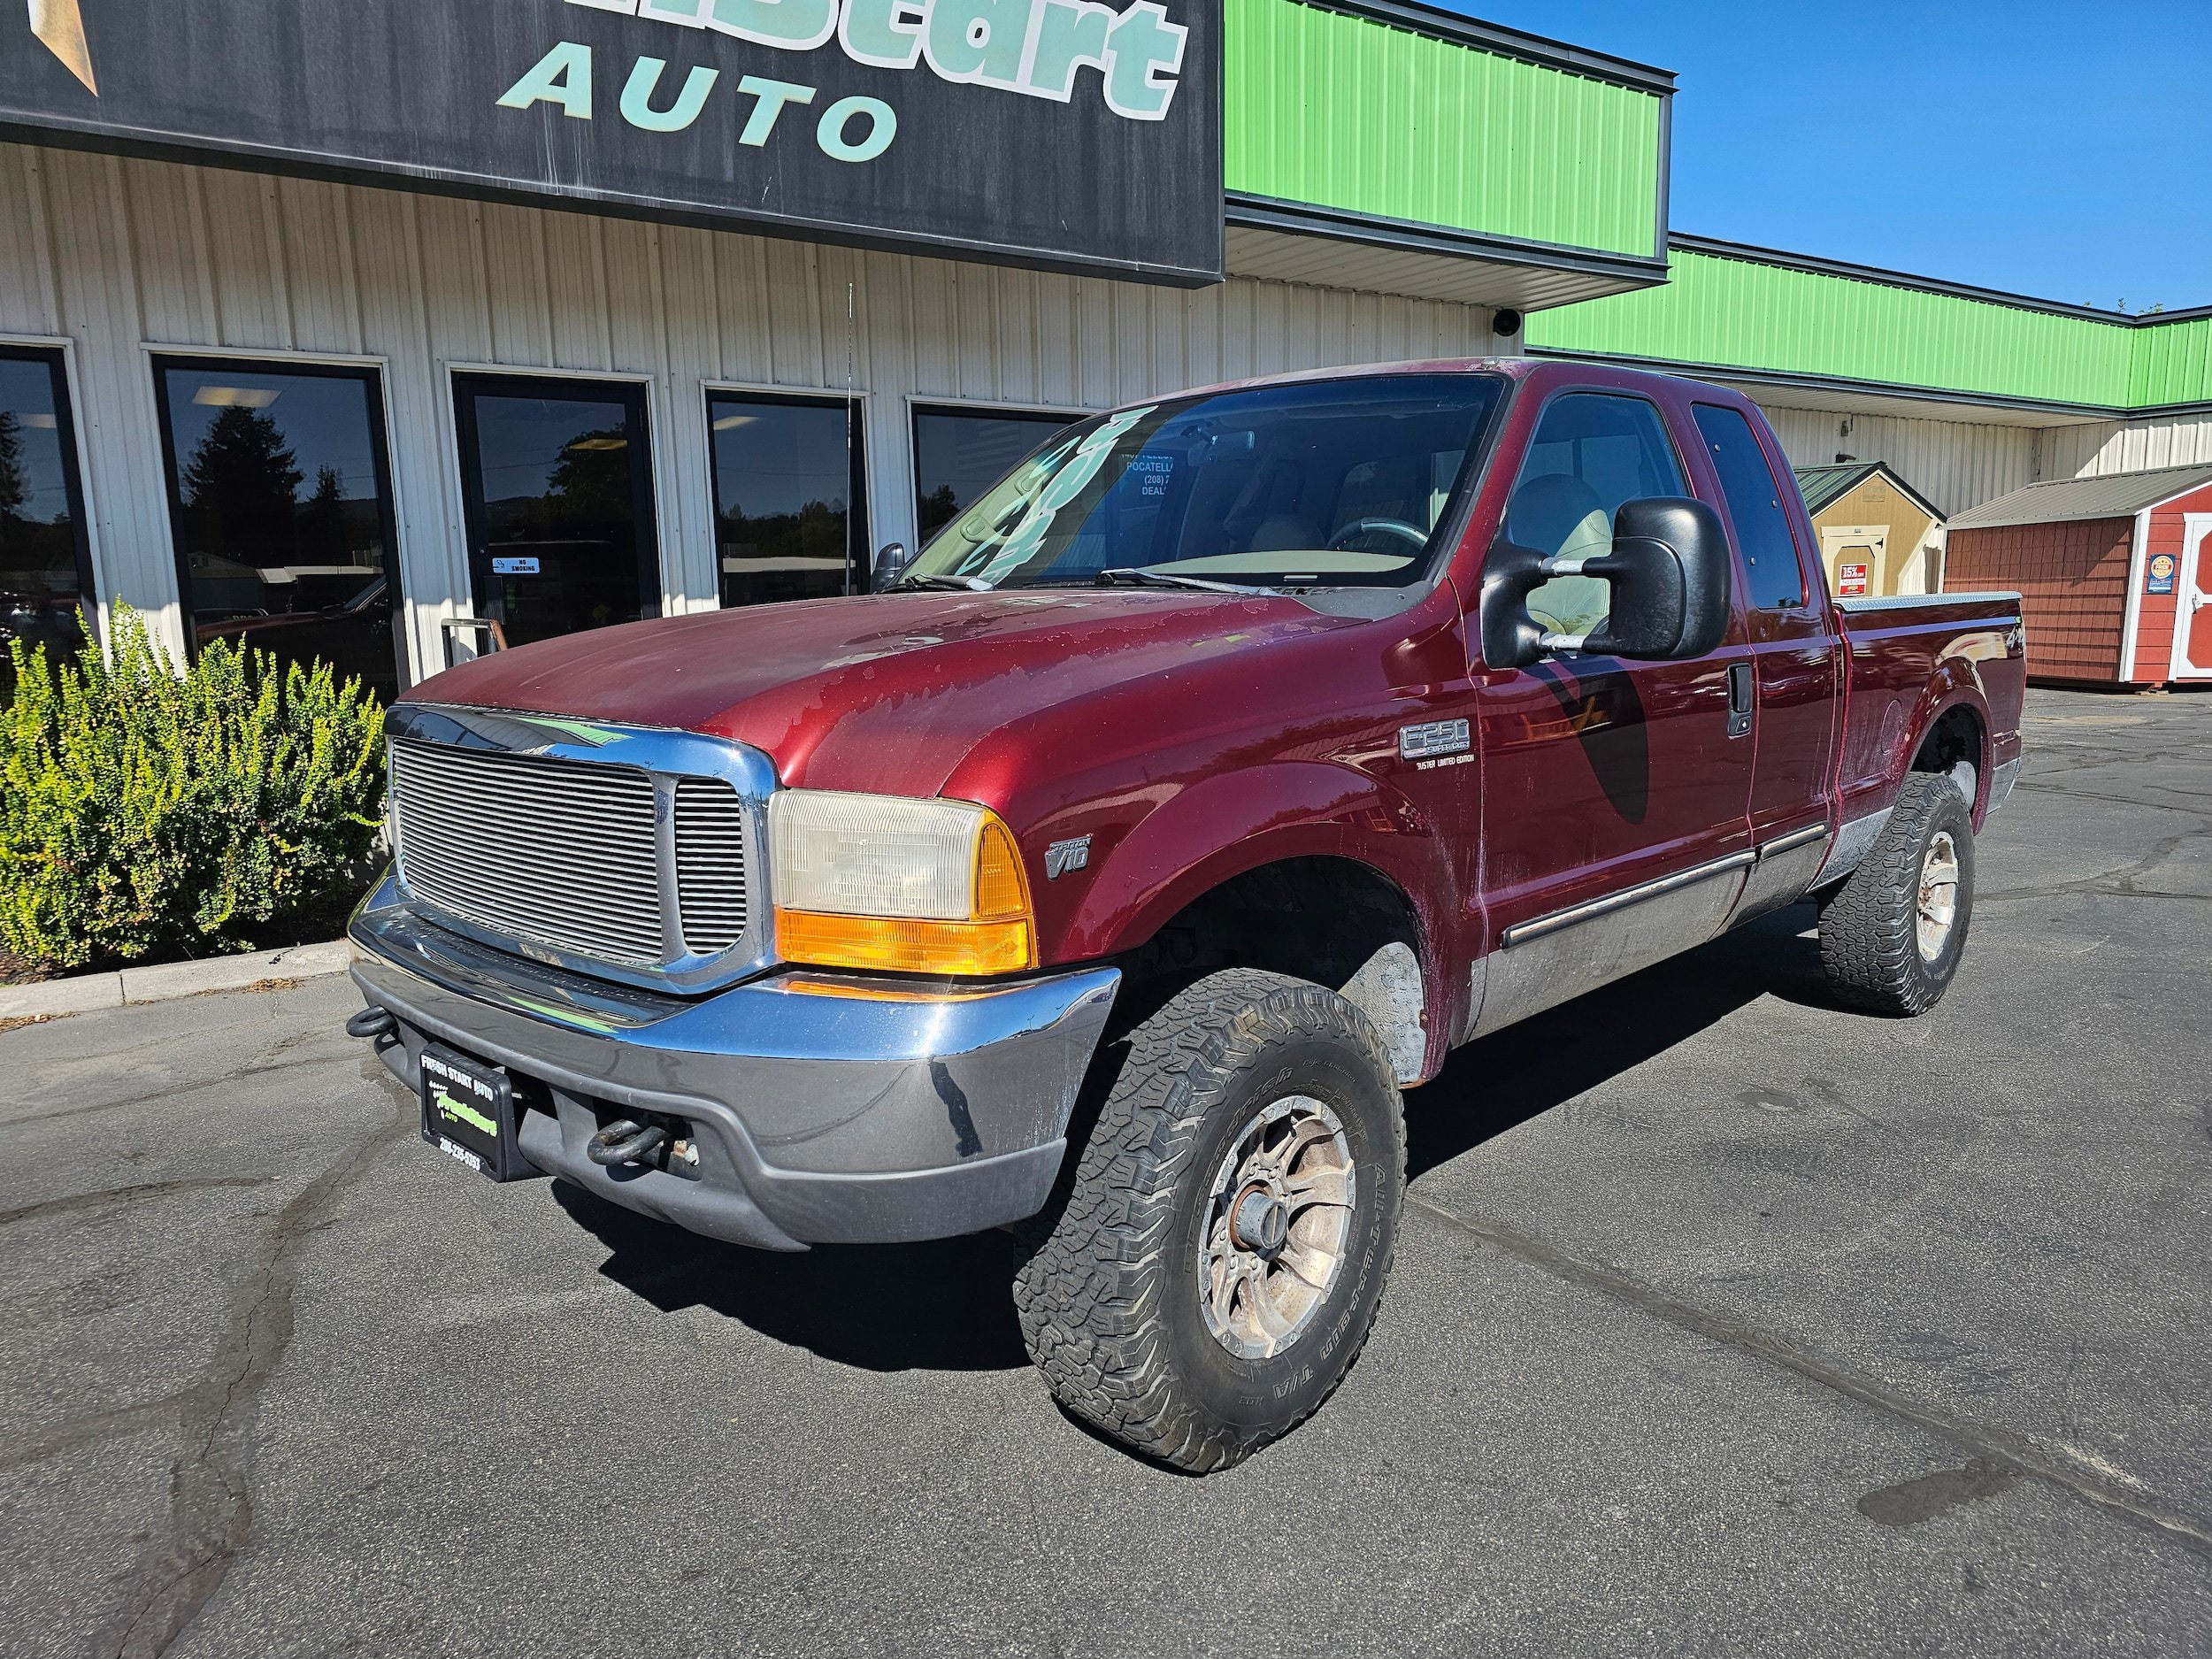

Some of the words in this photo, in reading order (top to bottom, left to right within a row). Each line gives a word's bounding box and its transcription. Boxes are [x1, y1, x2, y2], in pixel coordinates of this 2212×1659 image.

[495, 41, 898, 163] AUTO
[1126, 461, 1173, 472] POCATELL
[1144, 474, 1164, 486] (208)
[1141, 486, 1166, 495] DEAL
[1842, 566, 1858, 577] 15%
[1427, 745, 1451, 755] SUPER
[1437, 757, 1455, 766] LIMITED
[1456, 754, 1474, 764] EDITION
[1045, 847, 1089, 879] V10
[420, 1054, 448, 1078] FRESH
[448, 1066, 472, 1089] START
[473, 1079, 494, 1102] AUTO
[445, 1111, 458, 1123] AUTO
[1319, 1161, 1387, 1361] All-Terrain
[1273, 1363, 1316, 1401] T/A
